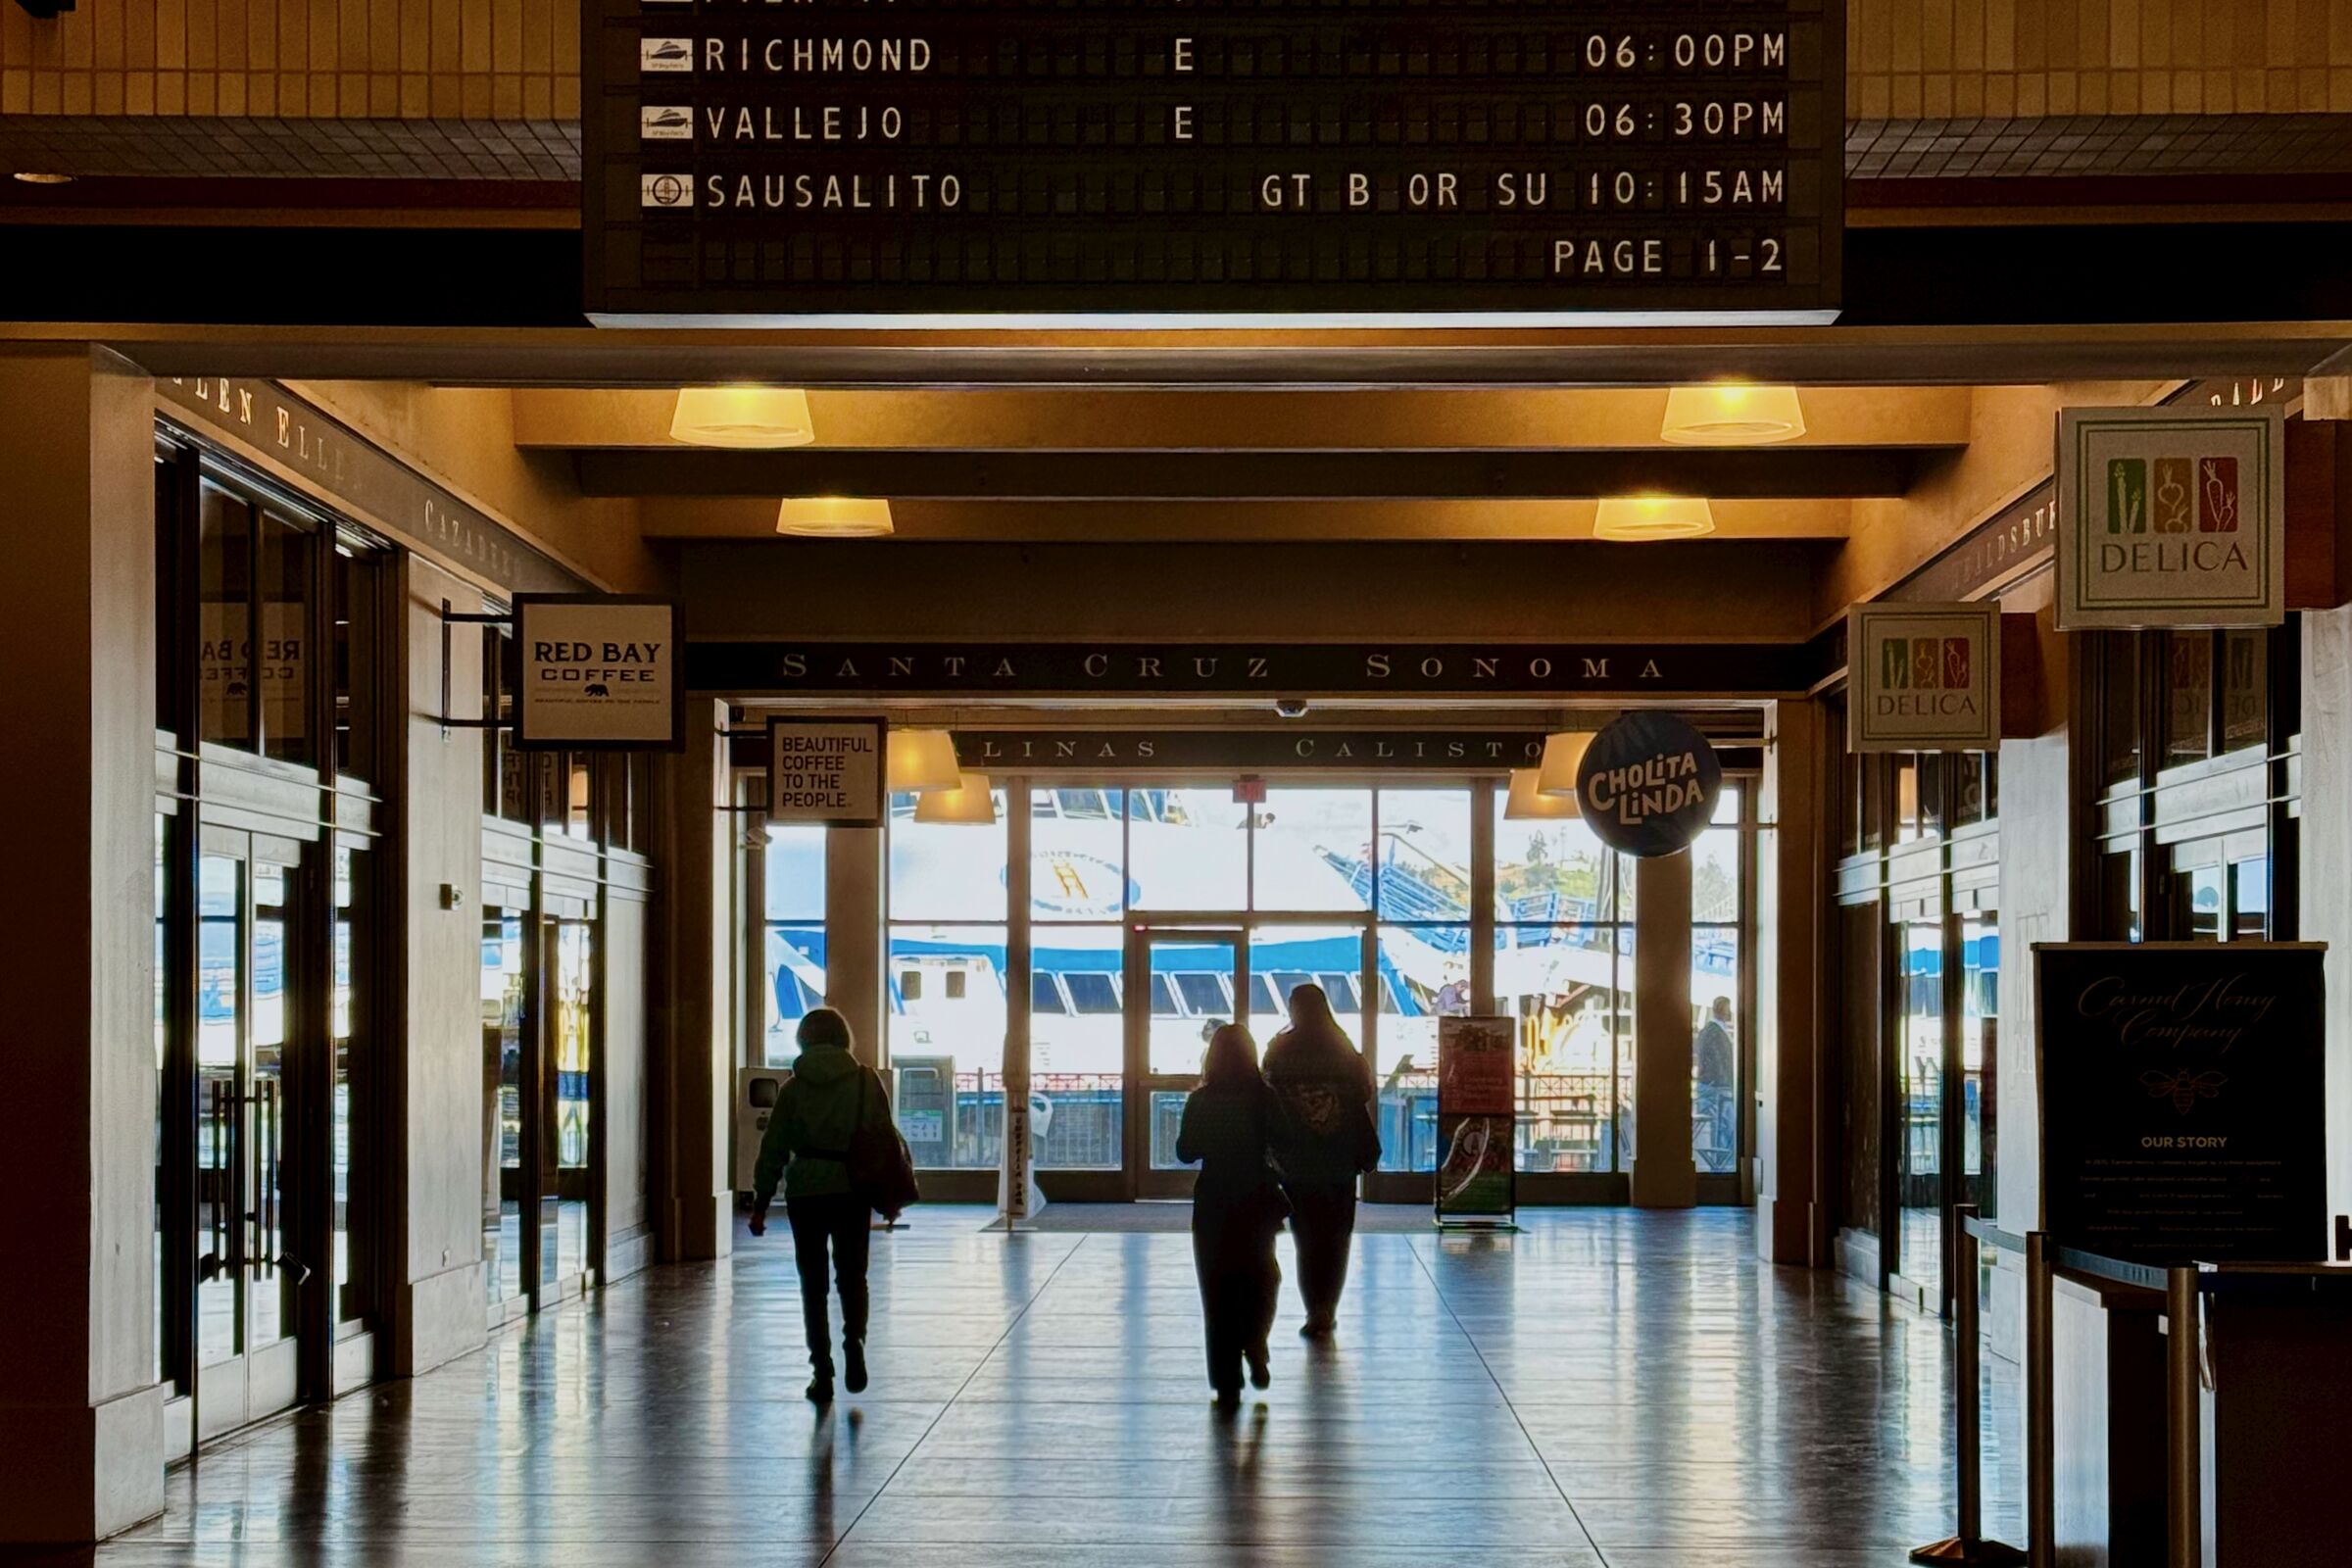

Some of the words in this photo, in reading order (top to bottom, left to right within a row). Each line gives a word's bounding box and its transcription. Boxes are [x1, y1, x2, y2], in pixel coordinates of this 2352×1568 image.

[706, 37, 931, 72] RICHMOND
[1175, 38, 1194, 72] E
[1587, 33, 1785, 68] 06:00PM
[707, 106, 902, 140] VALLEJO
[1175, 106, 1194, 139] E
[1586, 101, 1784, 136] 06:30PM
[708, 174, 960, 208] SAUSALITO
[1261, 173, 1311, 207] GT
[1349, 172, 1370, 206] B
[1409, 172, 1458, 206] OR
[1497, 172, 1546, 206] SU
[1590, 170, 1784, 205] 10:15AM
[1554, 240, 1662, 273] PAGE
[1707, 238, 1783, 272] 1-2
[172, 377, 253, 425] LEN
[2101, 541, 2248, 573] DELICA
[534, 641, 593, 663] RED
[602, 642, 662, 663] BAY
[541, 668, 655, 682] COFFEE
[783, 654, 1017, 677] SANTA
[1083, 654, 1268, 678] CRUZ
[1366, 654, 1663, 678] SONOMA
[1877, 693, 1977, 715] DELICA
[782, 736, 873, 754] BEAUTIFUL
[955, 741, 1154, 759] LINAS
[1296, 739, 1542, 759] CALISTO
[782, 756, 845, 771] COFFEE
[783, 773, 804, 789] TO
[808, 773, 840, 789] THE
[2112, 1007, 2246, 1055] Company
[2140, 1135, 2174, 1150] OUR
[2177, 1135, 2229, 1150] STORY
